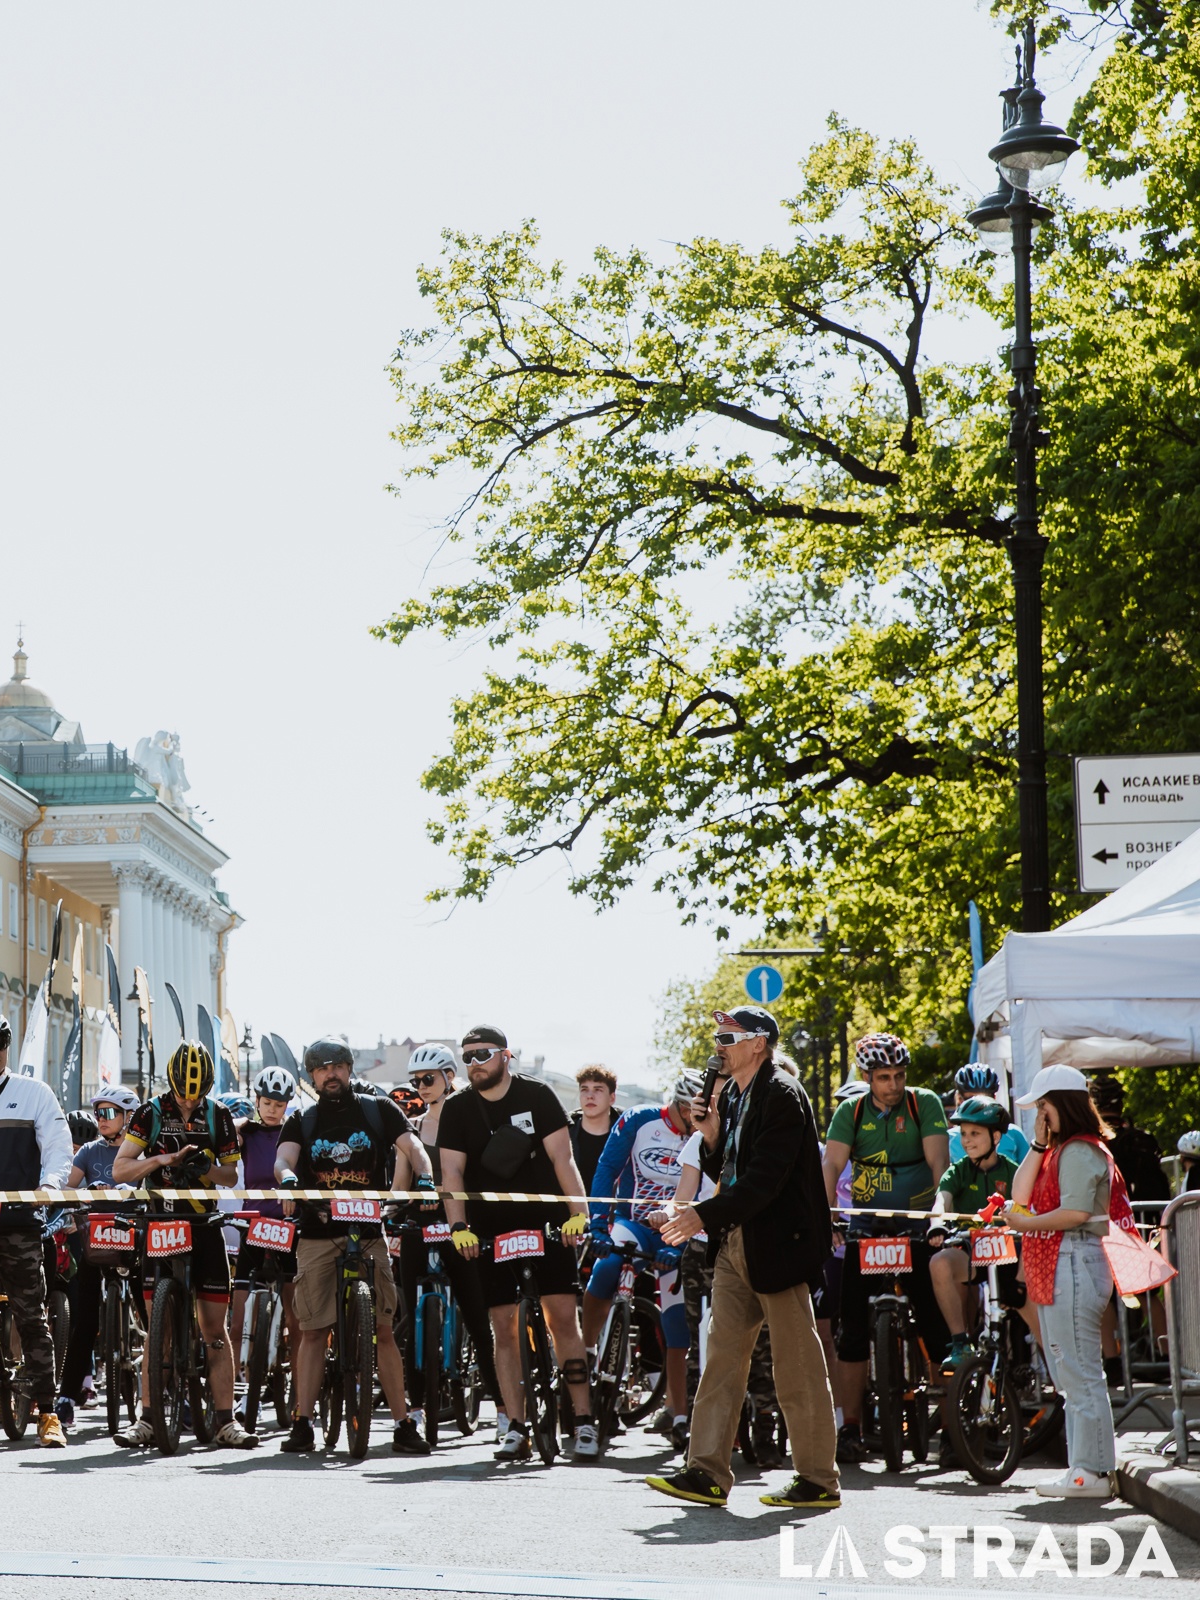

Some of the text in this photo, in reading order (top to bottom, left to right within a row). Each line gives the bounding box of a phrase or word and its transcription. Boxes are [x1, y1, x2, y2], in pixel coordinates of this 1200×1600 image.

[1123, 793, 1184, 803] площадь
[337, 1202, 374, 1215] 6140
[151, 1227, 186, 1249] 6144
[252, 1221, 289, 1244] 4363
[499, 1235, 539, 1255] 7059
[865, 1245, 906, 1266] 4007
[975, 1235, 1008, 1258] 6511
